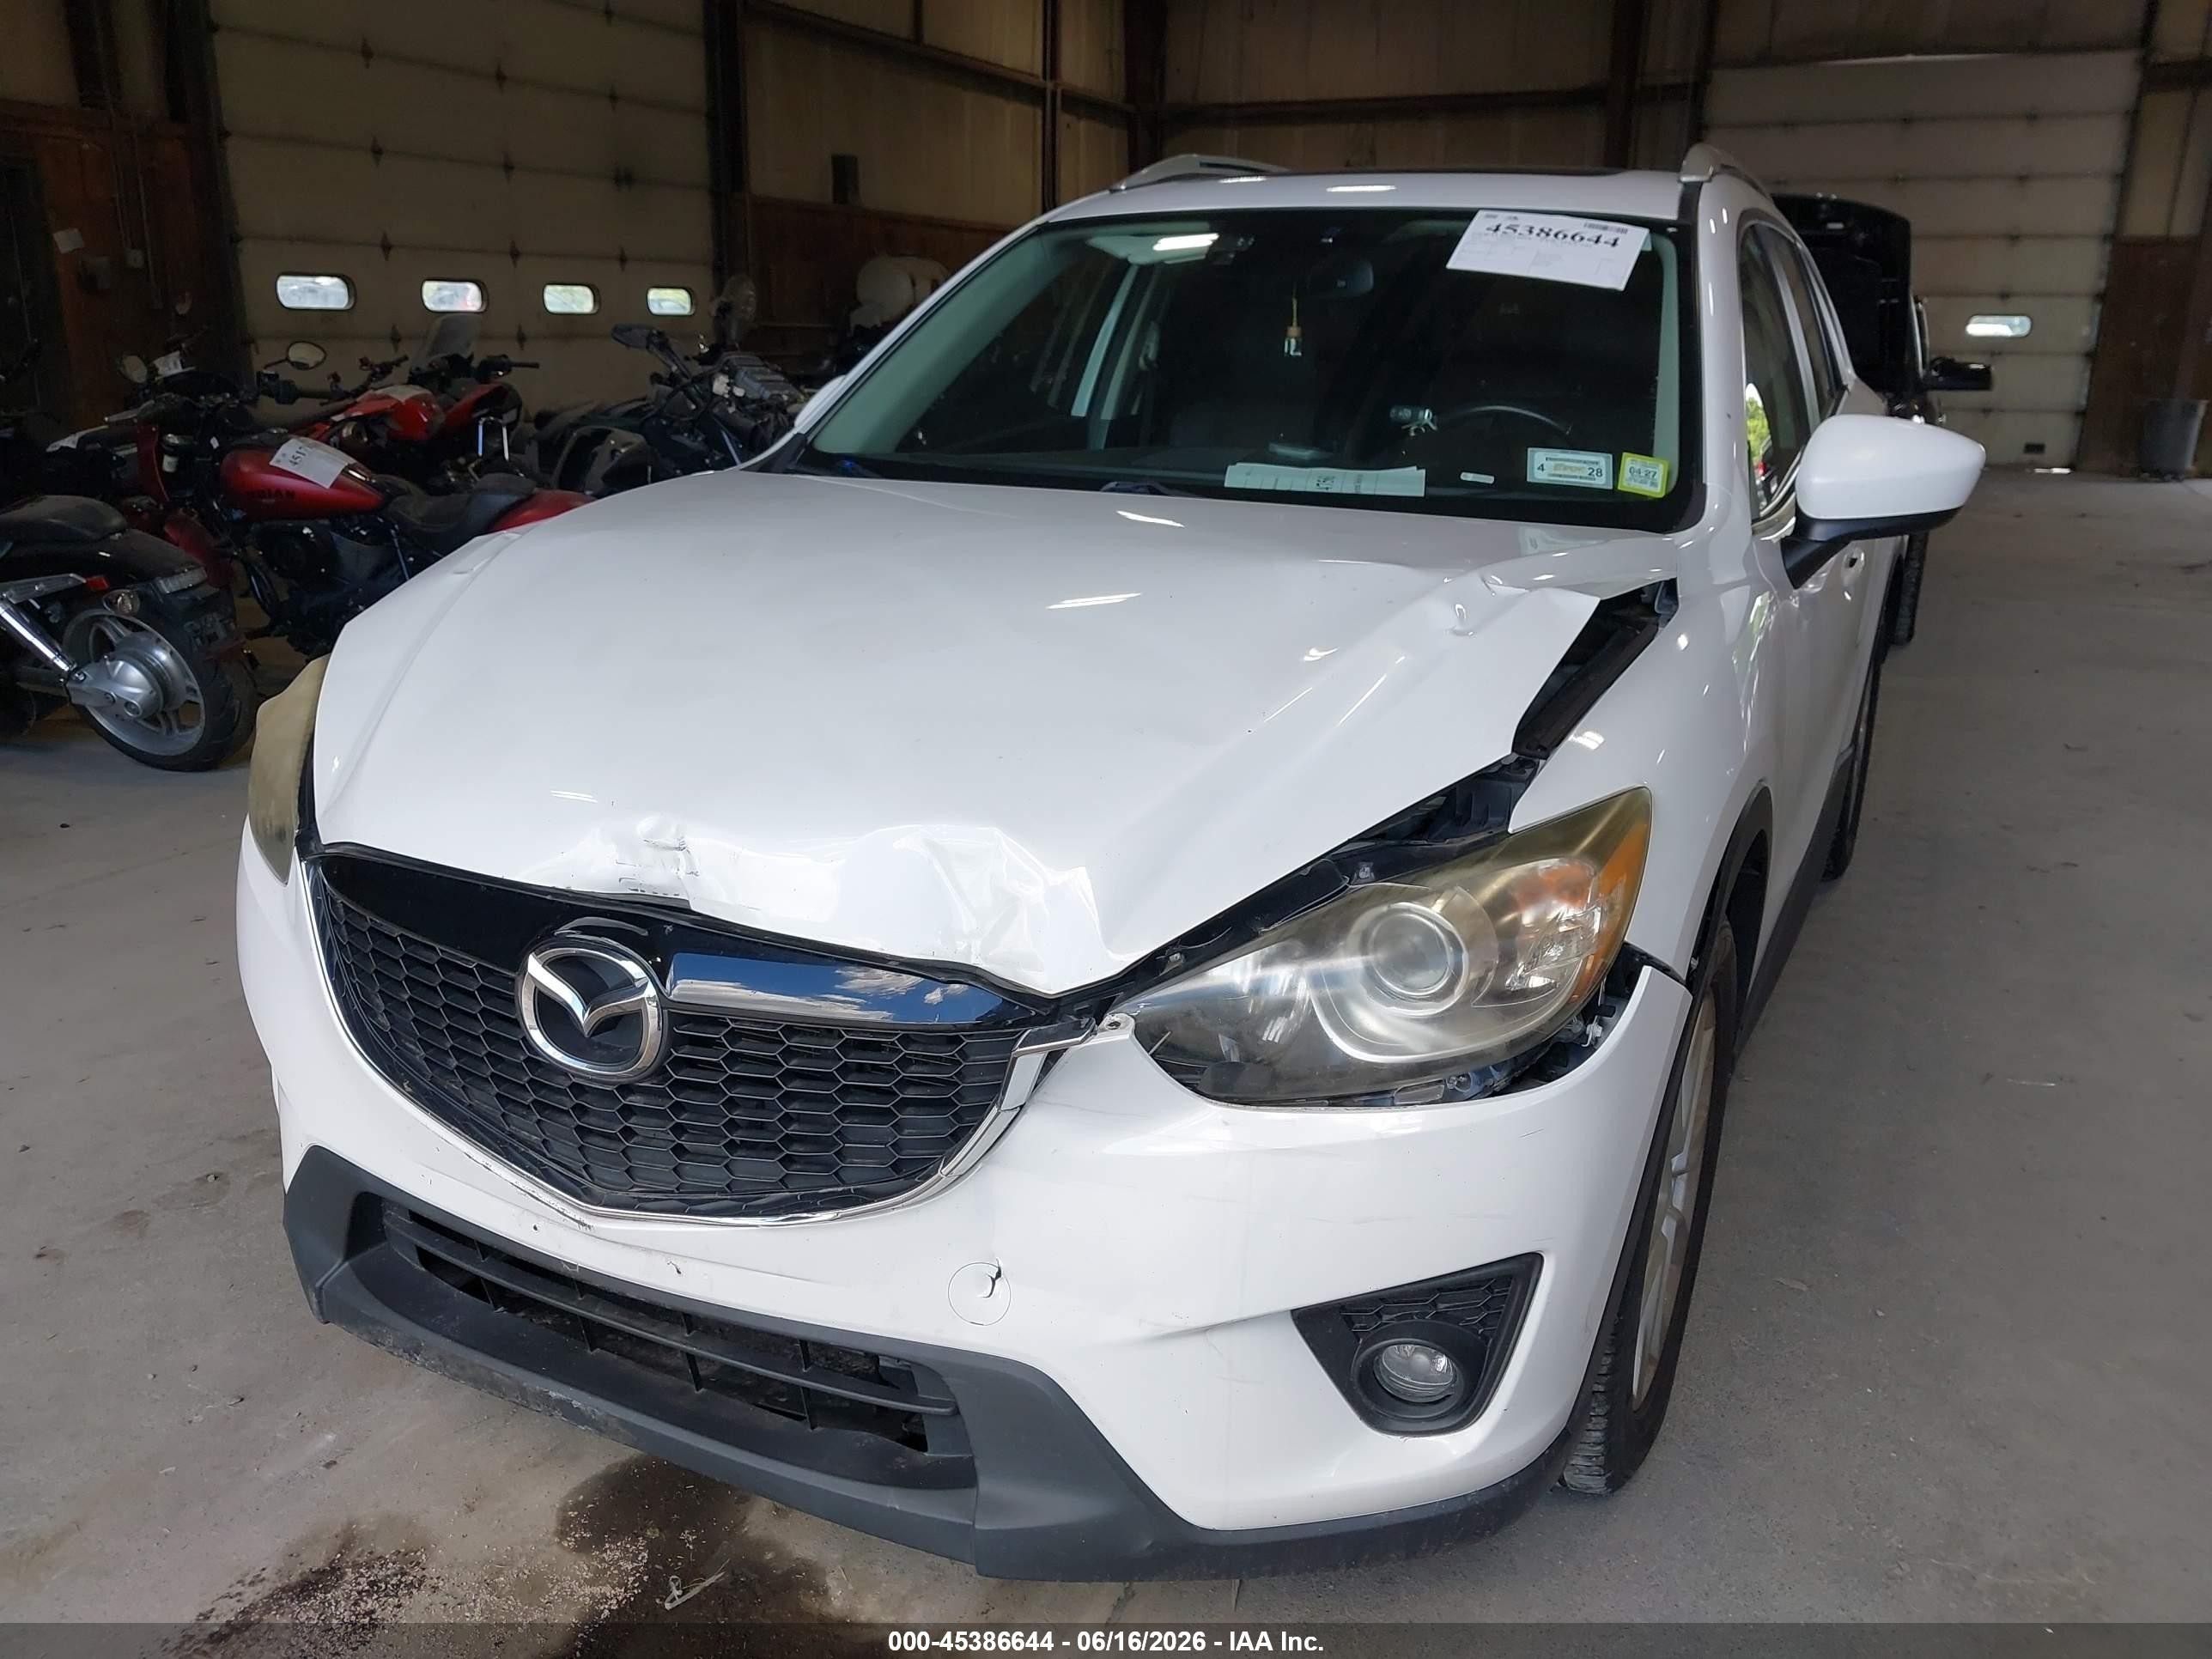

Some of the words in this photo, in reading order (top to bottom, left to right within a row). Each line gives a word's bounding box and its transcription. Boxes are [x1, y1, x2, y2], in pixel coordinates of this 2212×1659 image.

[1486, 222, 1620, 248] 45386644
[1537, 463, 1546, 472] 4
[1588, 467, 1603, 477] 28
